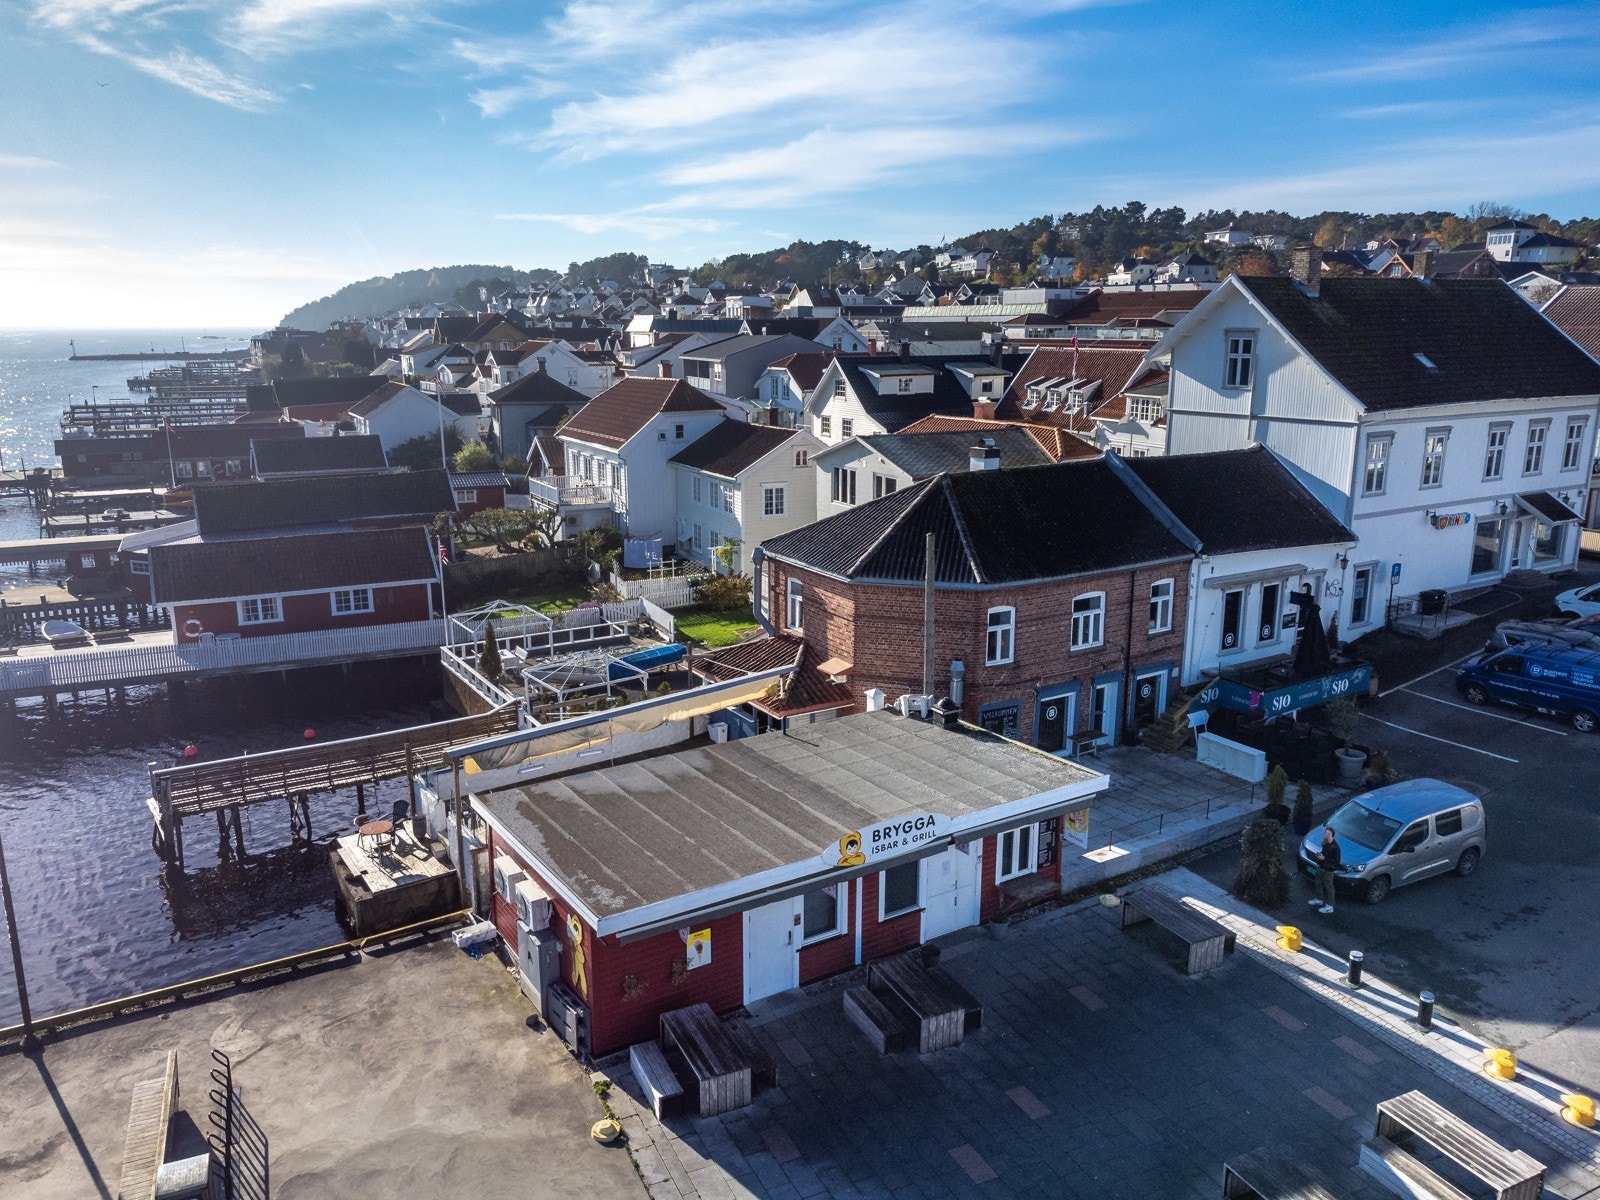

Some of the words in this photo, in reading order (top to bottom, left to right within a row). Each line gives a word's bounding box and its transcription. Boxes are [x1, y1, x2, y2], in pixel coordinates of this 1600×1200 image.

[872, 814, 936, 843] BRYGGA
[871, 837, 898, 855] ISBAR
[902, 837, 909, 846] &
[912, 830, 937, 843] GRILL
